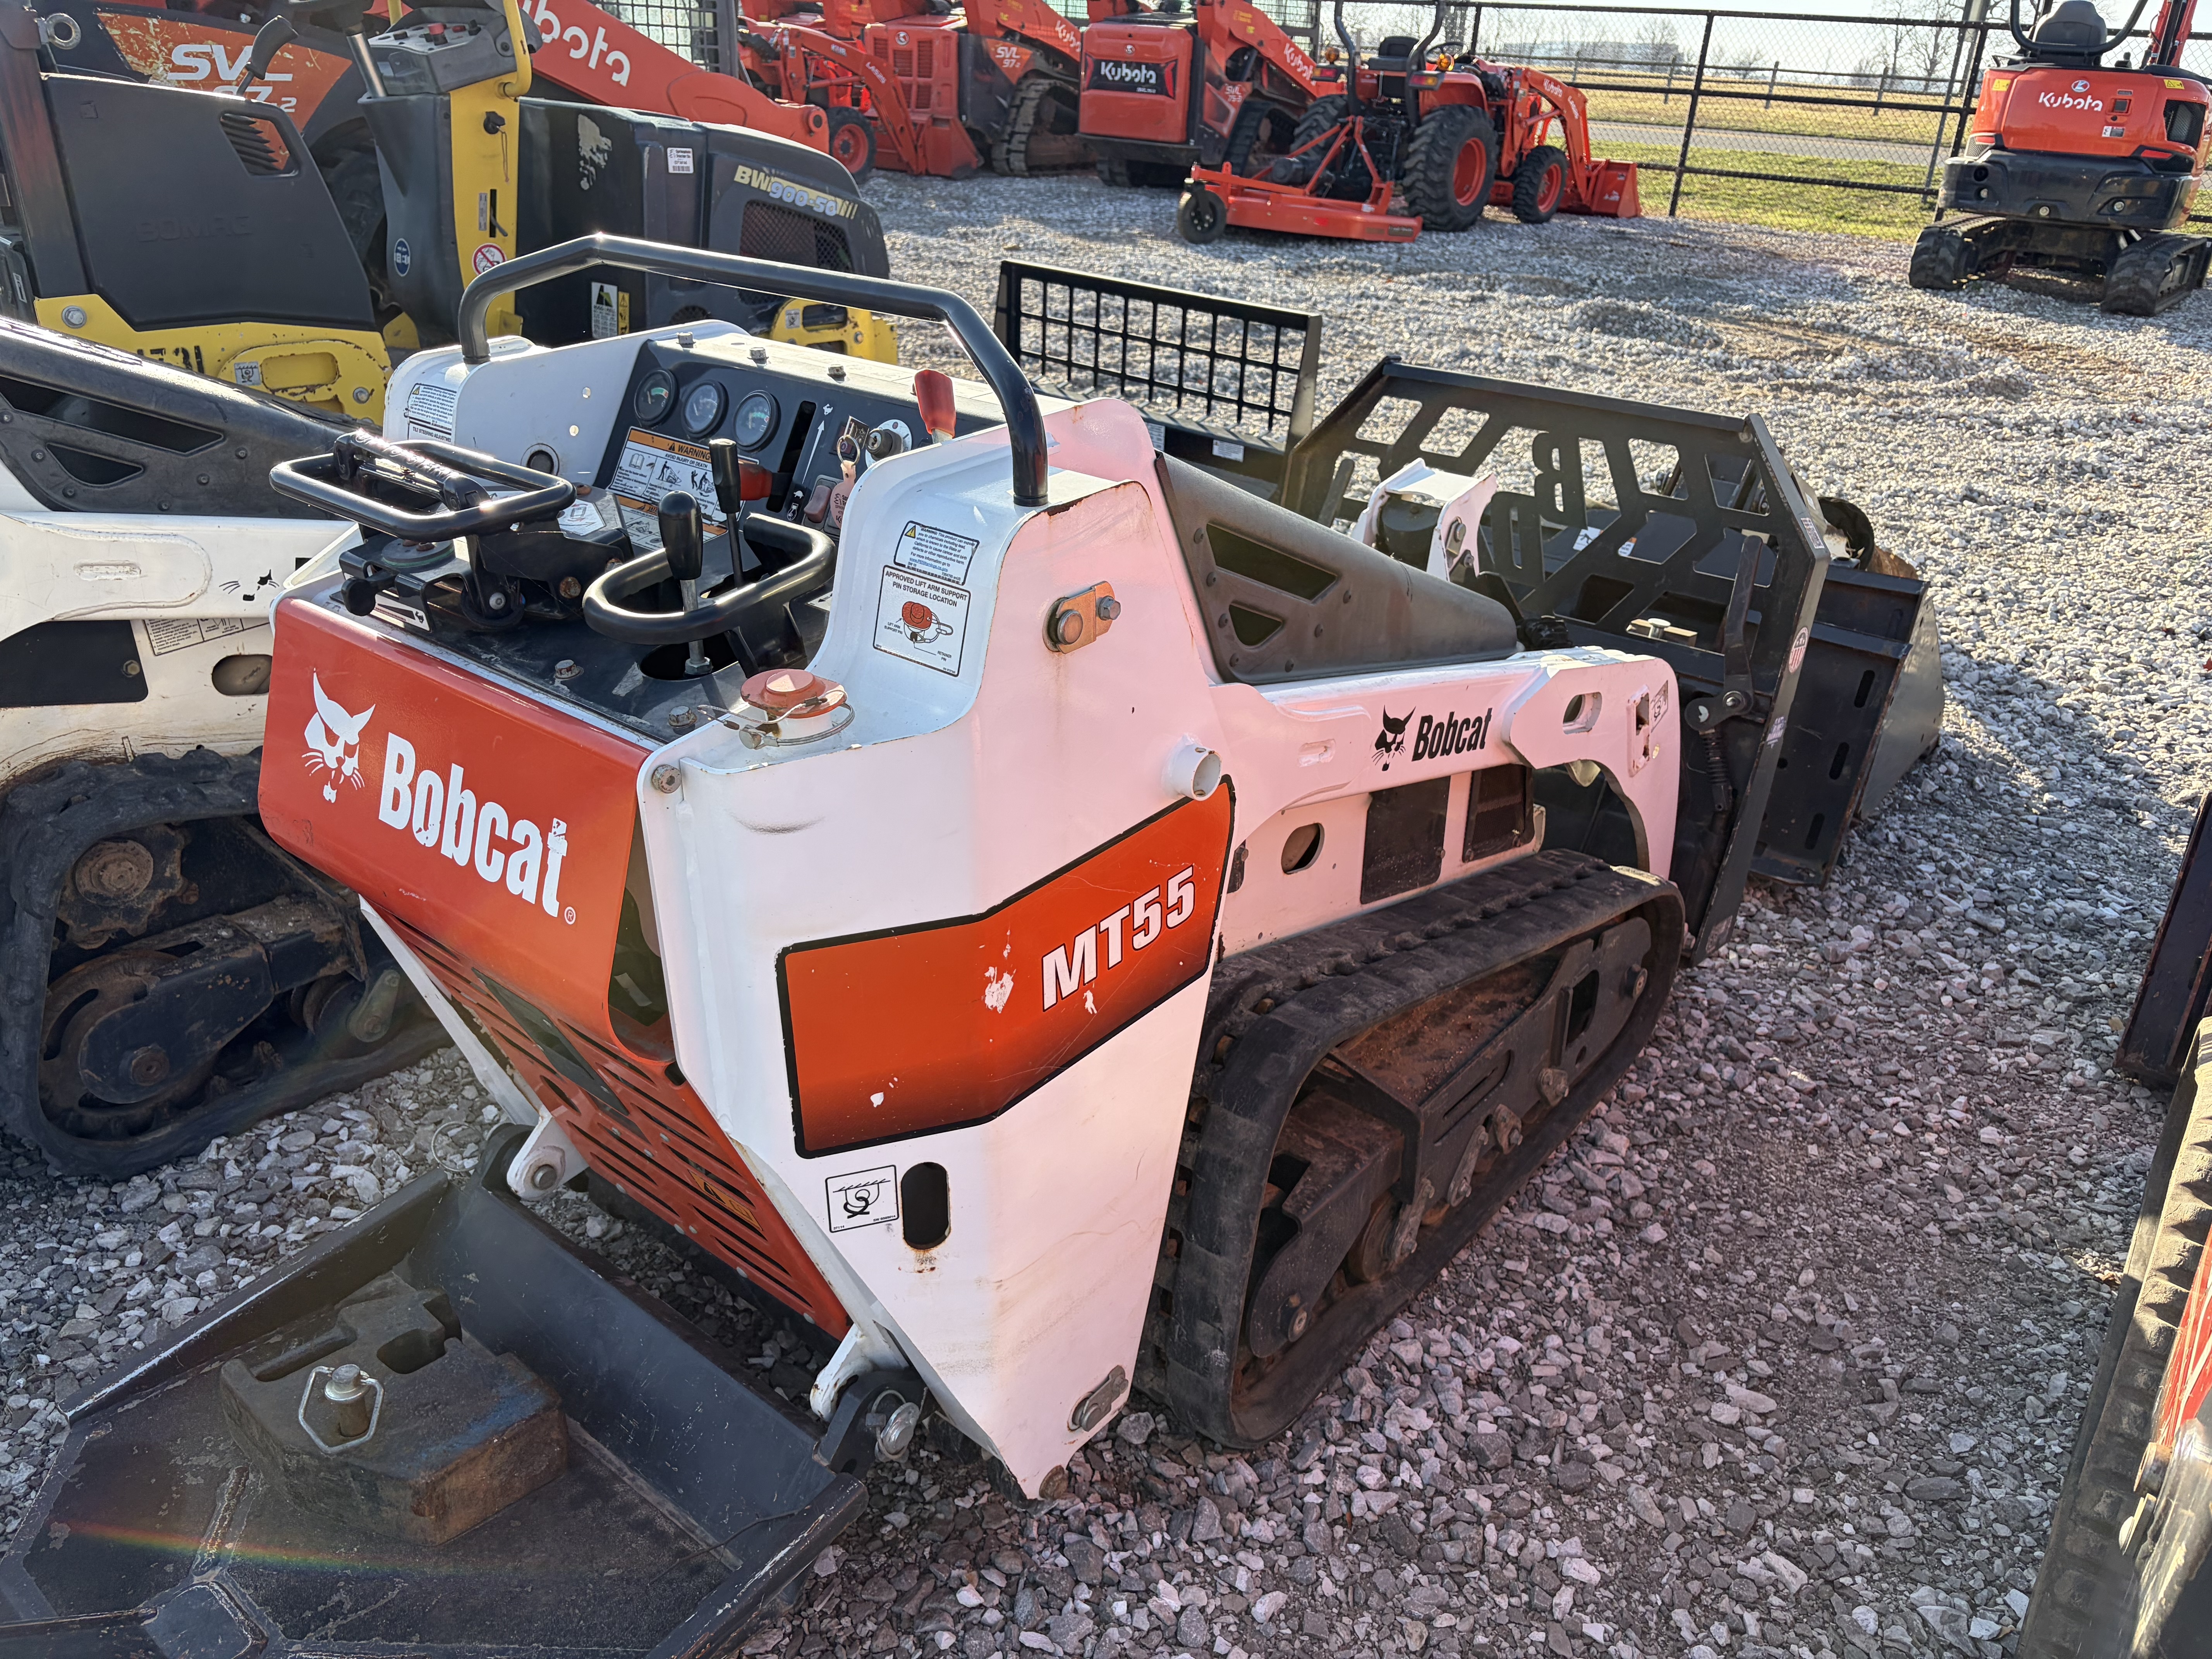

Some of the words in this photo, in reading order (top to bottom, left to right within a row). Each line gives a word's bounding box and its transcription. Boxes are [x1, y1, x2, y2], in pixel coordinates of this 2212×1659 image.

[523, 0, 630, 87] bota
[1055, 20, 1081, 52] Kubo
[995, 46, 1020, 58] SVL
[1284, 43, 1316, 86] Kubot
[1101, 62, 1157, 84] Kubota
[2039, 92, 2103, 111] Kubota
[676, 456, 689, 464] INJURY
[678, 445, 711, 461] WARNING
[925, 556, 942, 564] information
[936, 553, 956, 562] reproductive
[885, 570, 914, 584] APPROVED
[915, 580, 927, 588] LIFT
[927, 584, 940, 592] ARM
[941, 588, 968, 601] SUPPORT
[893, 581, 902, 589] PIN
[903, 584, 928, 598] STORAGE
[929, 593, 957, 607] LOCATION
[1412, 708, 1492, 761] Bobcat
[379, 732, 568, 917] Bobcat
[1042, 864, 1195, 1012] MT55
